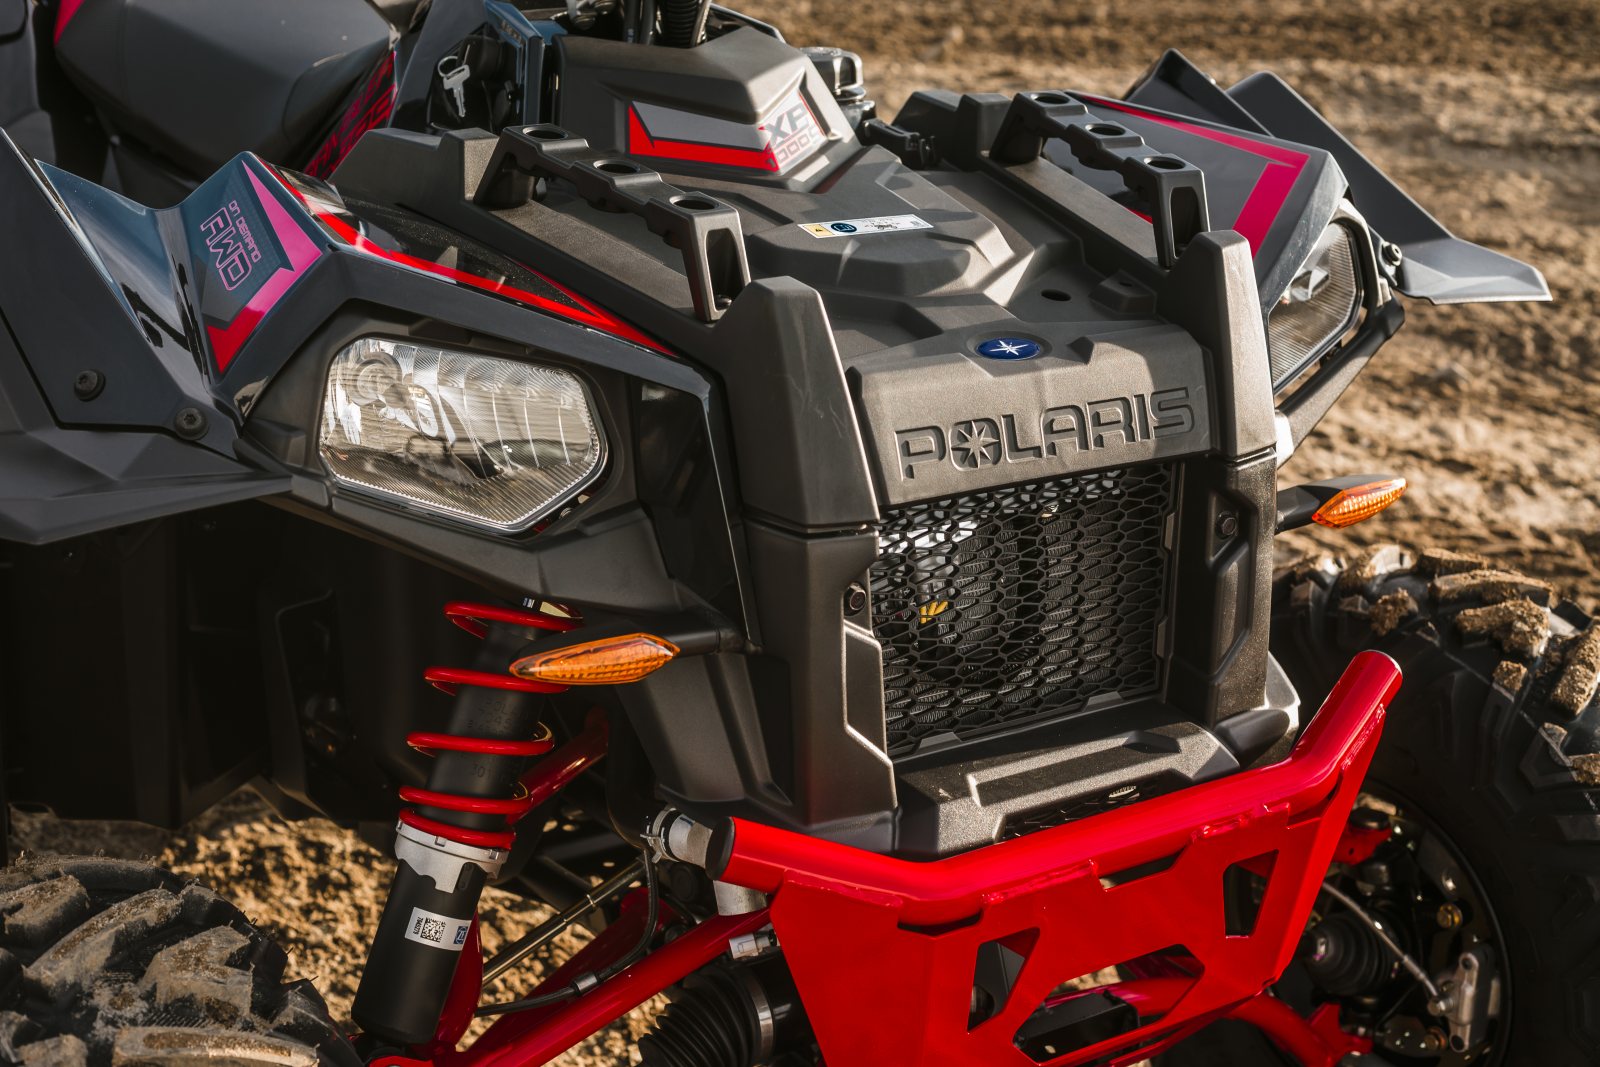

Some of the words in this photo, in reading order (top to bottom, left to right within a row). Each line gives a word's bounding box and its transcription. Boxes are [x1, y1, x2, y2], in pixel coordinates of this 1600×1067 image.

[766, 103, 808, 145] XP
[200, 207, 252, 291] AWD
[894, 386, 1195, 482] POLARIS
